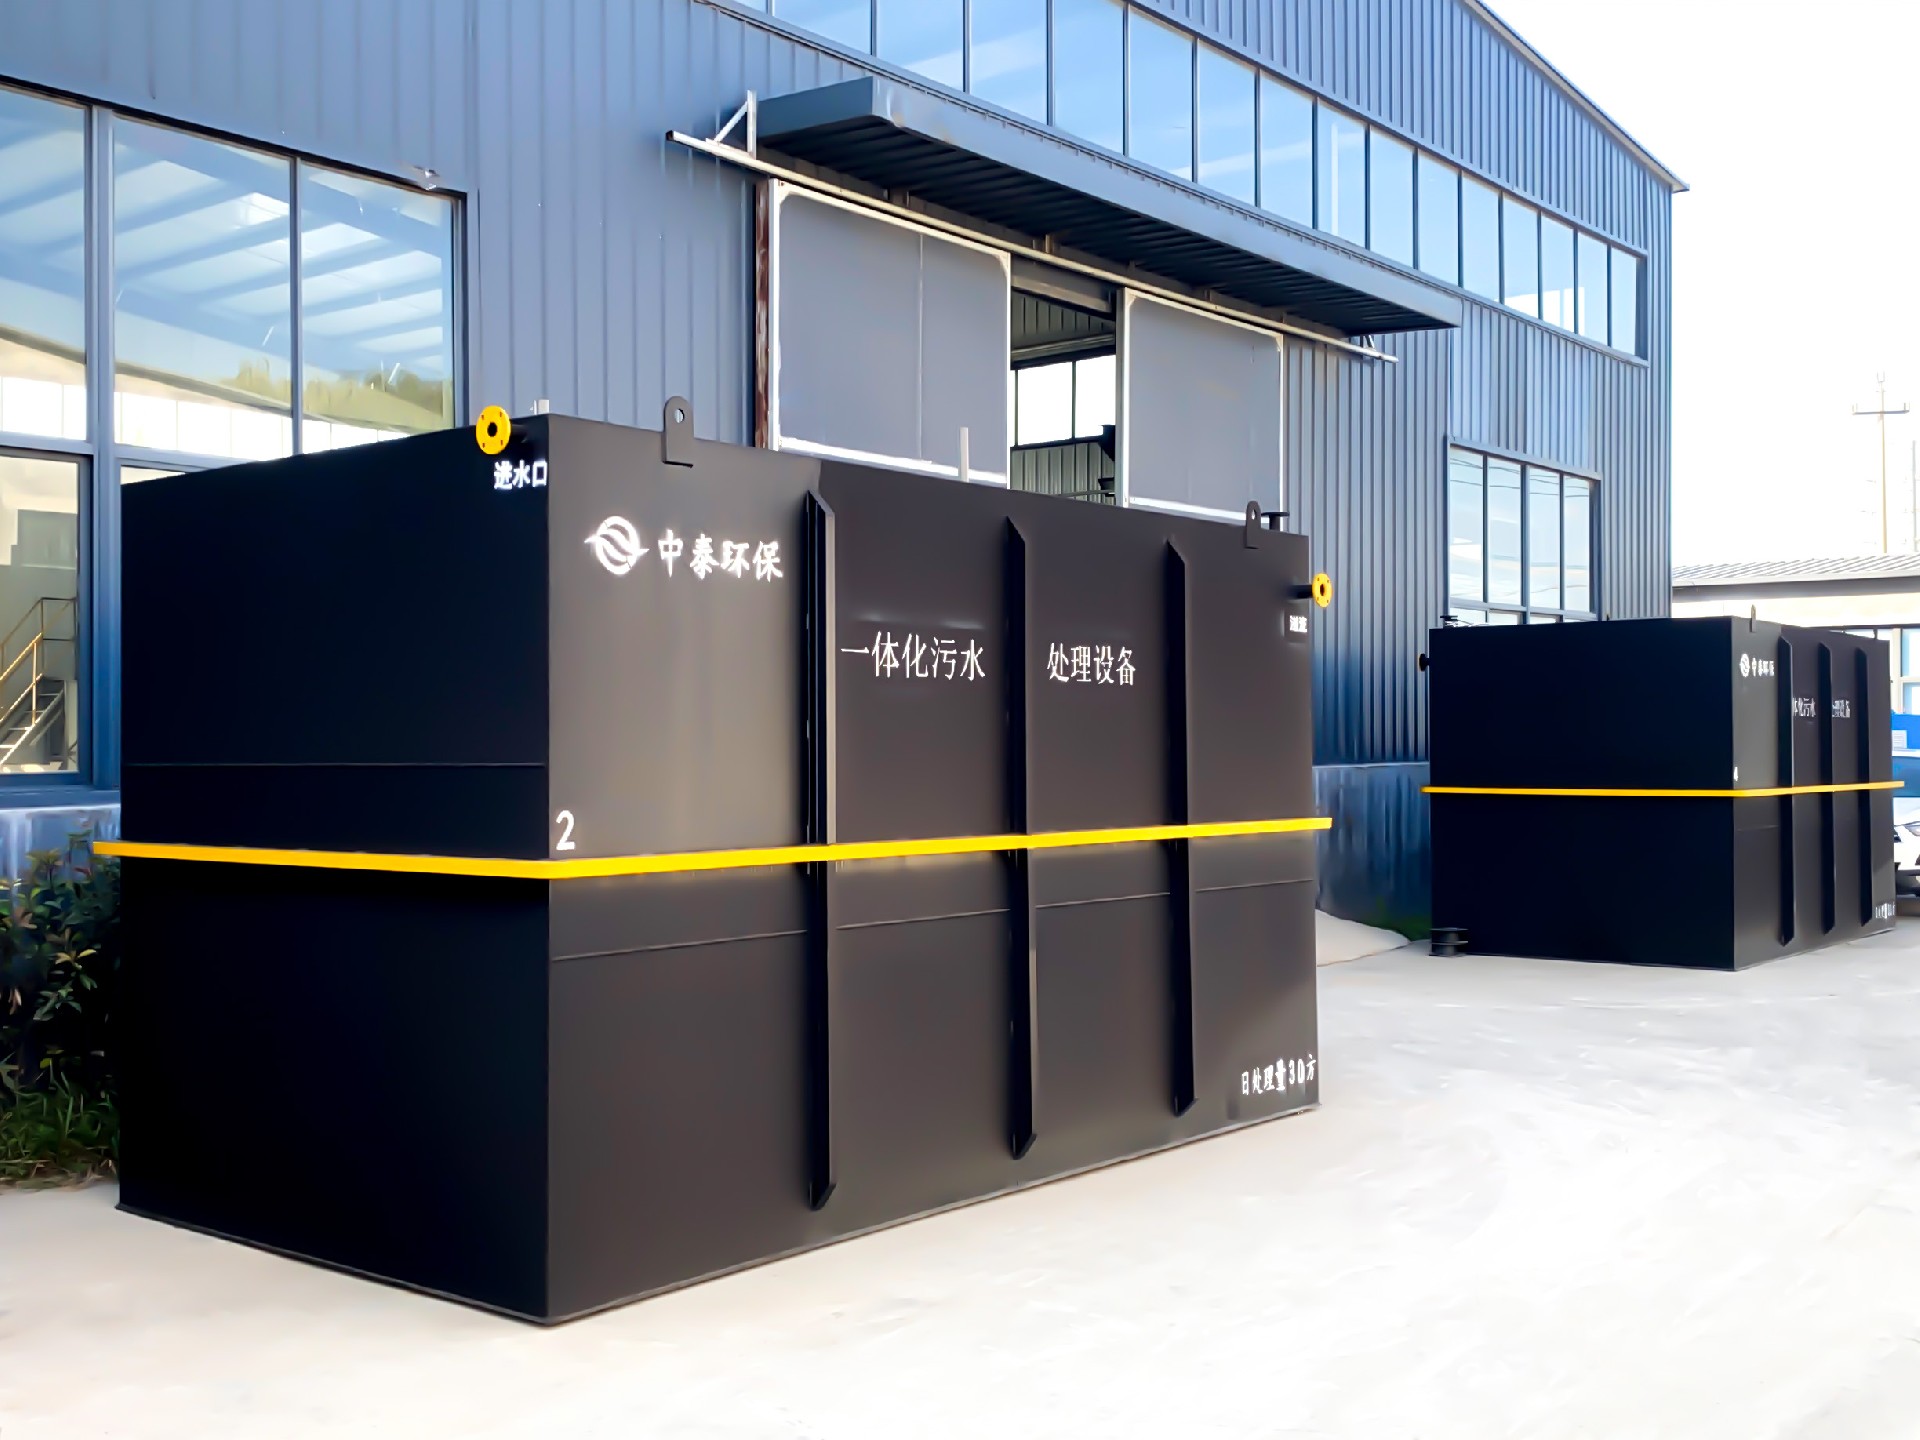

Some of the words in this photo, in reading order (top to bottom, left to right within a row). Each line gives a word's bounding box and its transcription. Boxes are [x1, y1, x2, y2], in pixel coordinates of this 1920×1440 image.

[493, 460, 547, 490] 进水口
[658, 529, 783, 582] 中泰环保
[841, 631, 985, 681] 一体化污水
[1047, 642, 1136, 686] 处理设备
[556, 810, 575, 850] 2
